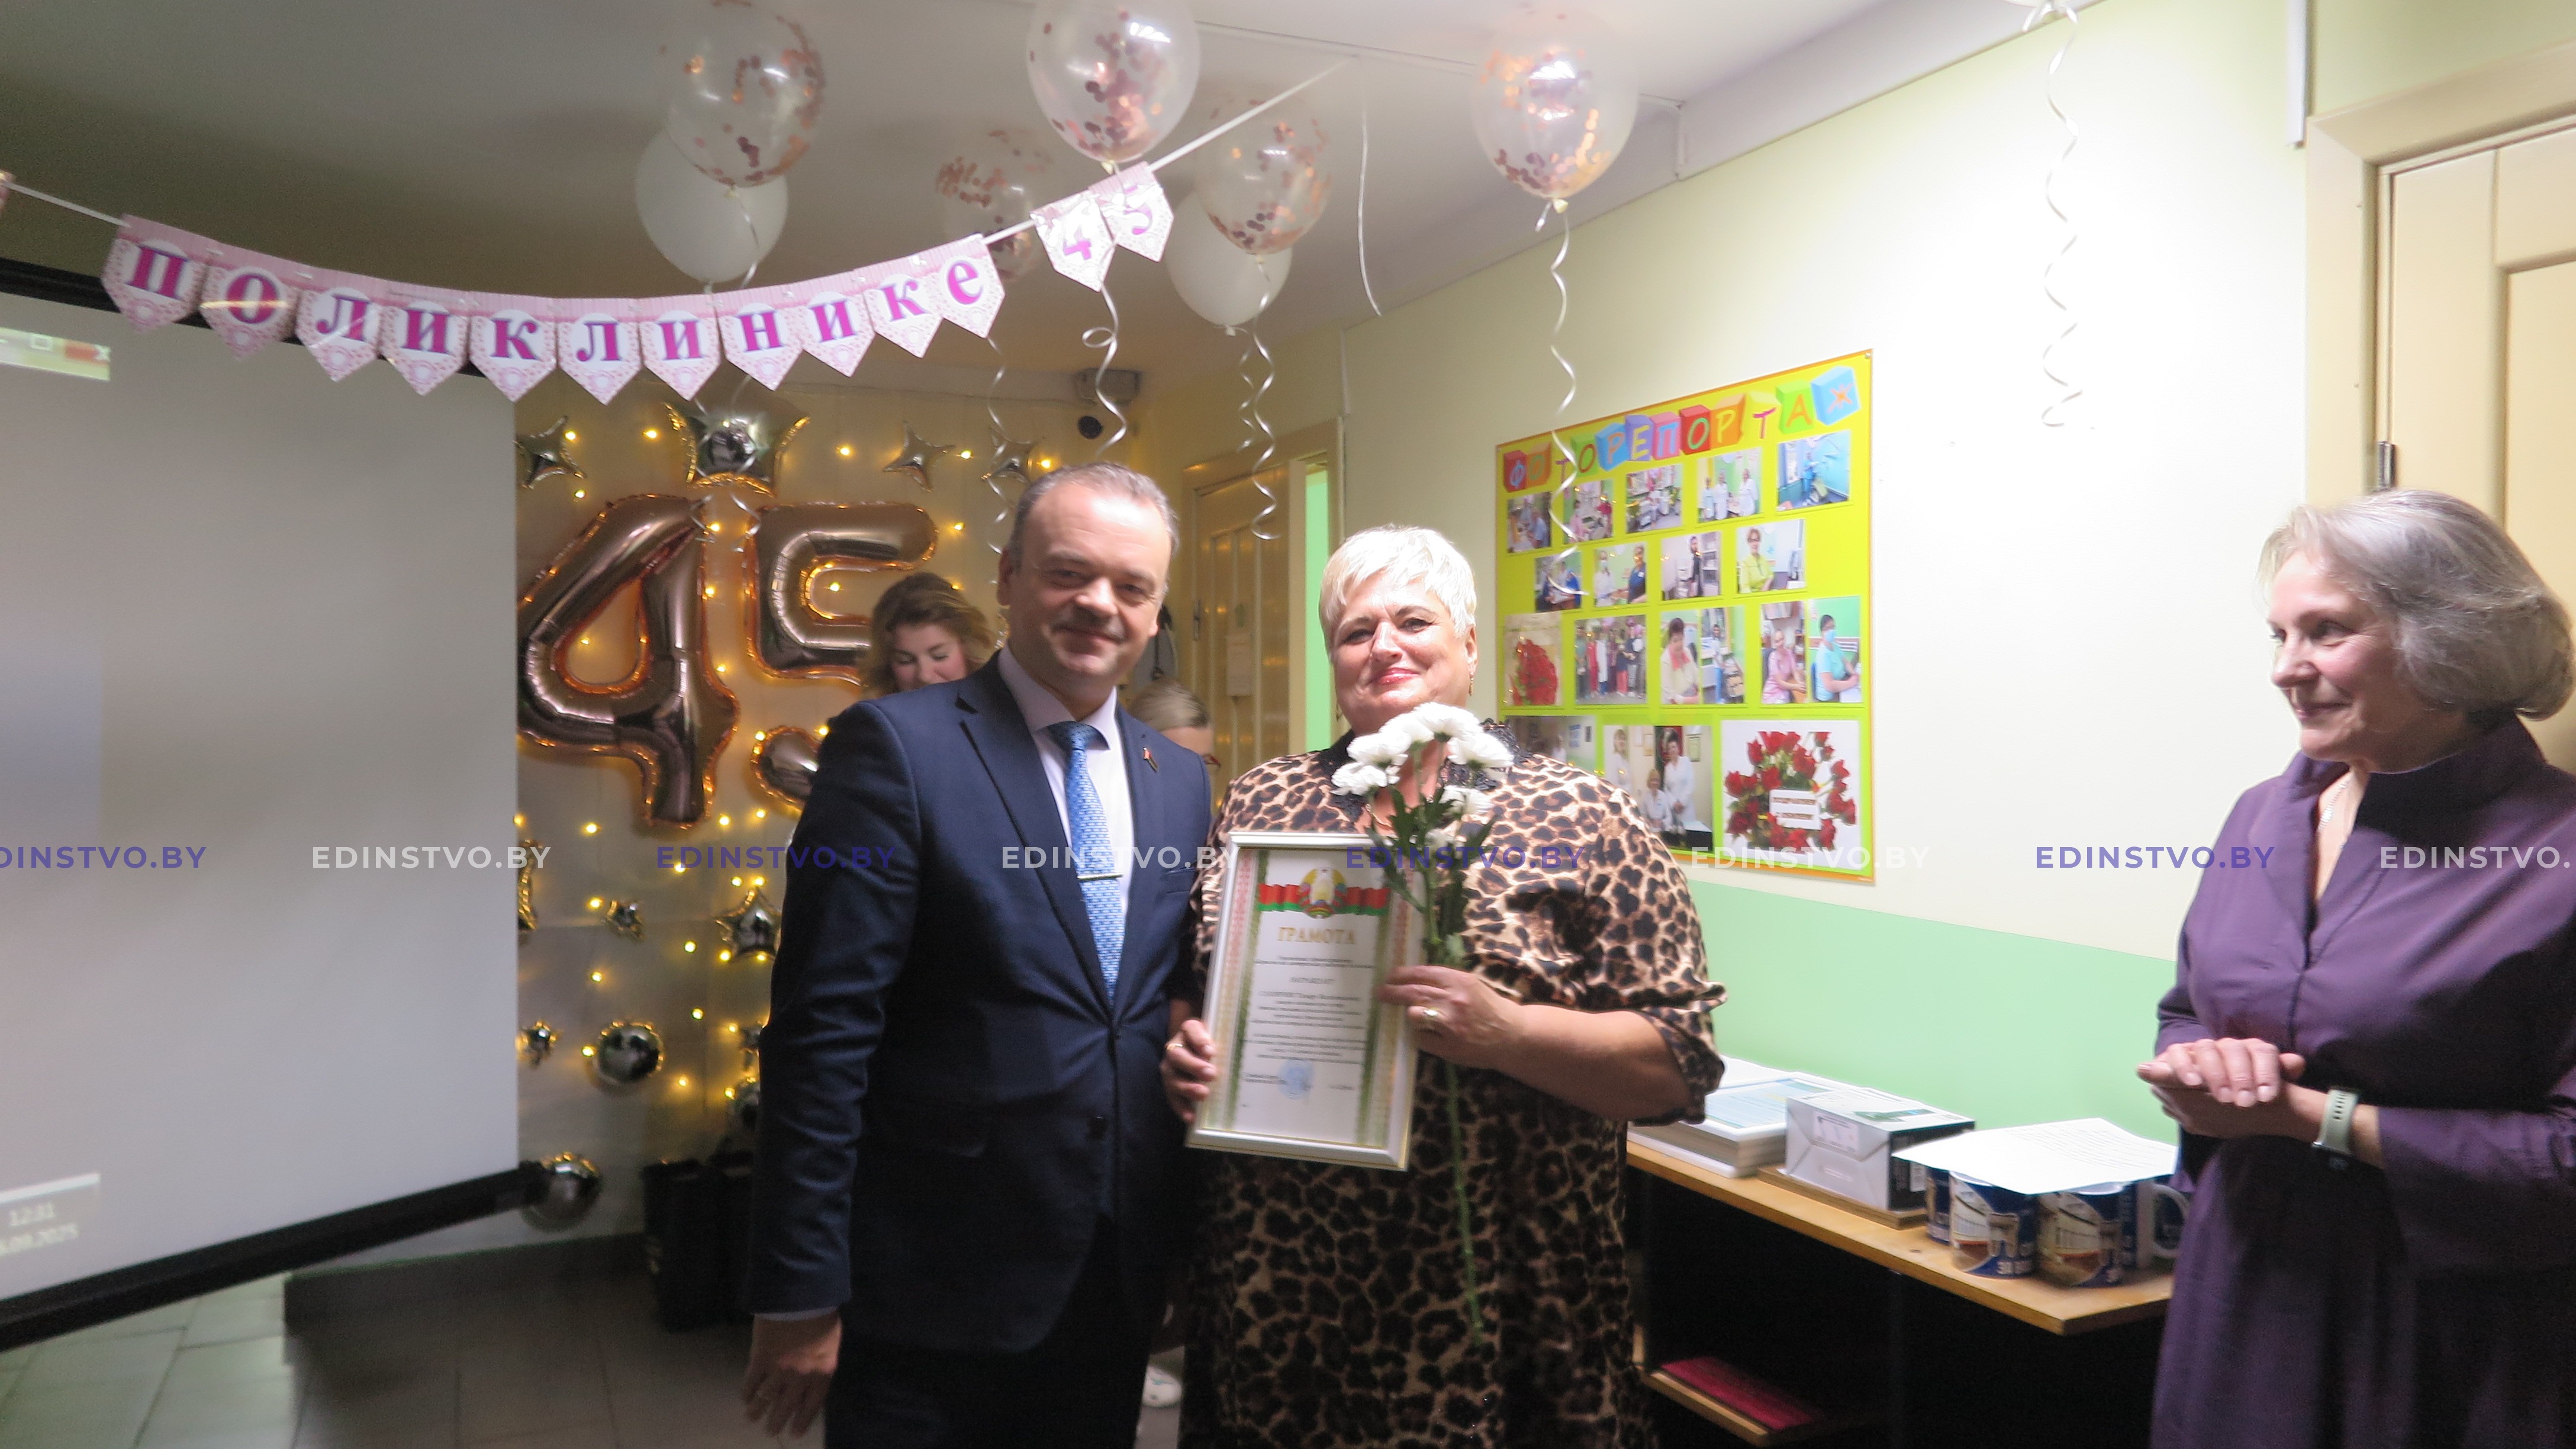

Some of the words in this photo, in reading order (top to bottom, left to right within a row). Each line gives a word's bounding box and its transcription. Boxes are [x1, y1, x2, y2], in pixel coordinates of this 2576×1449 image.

[1511, 382, 1854, 490] ФОТОРЕПОРТАЖ
[517, 493, 939, 828] 45
[1277, 926, 1356, 945] ГРАМОТА
